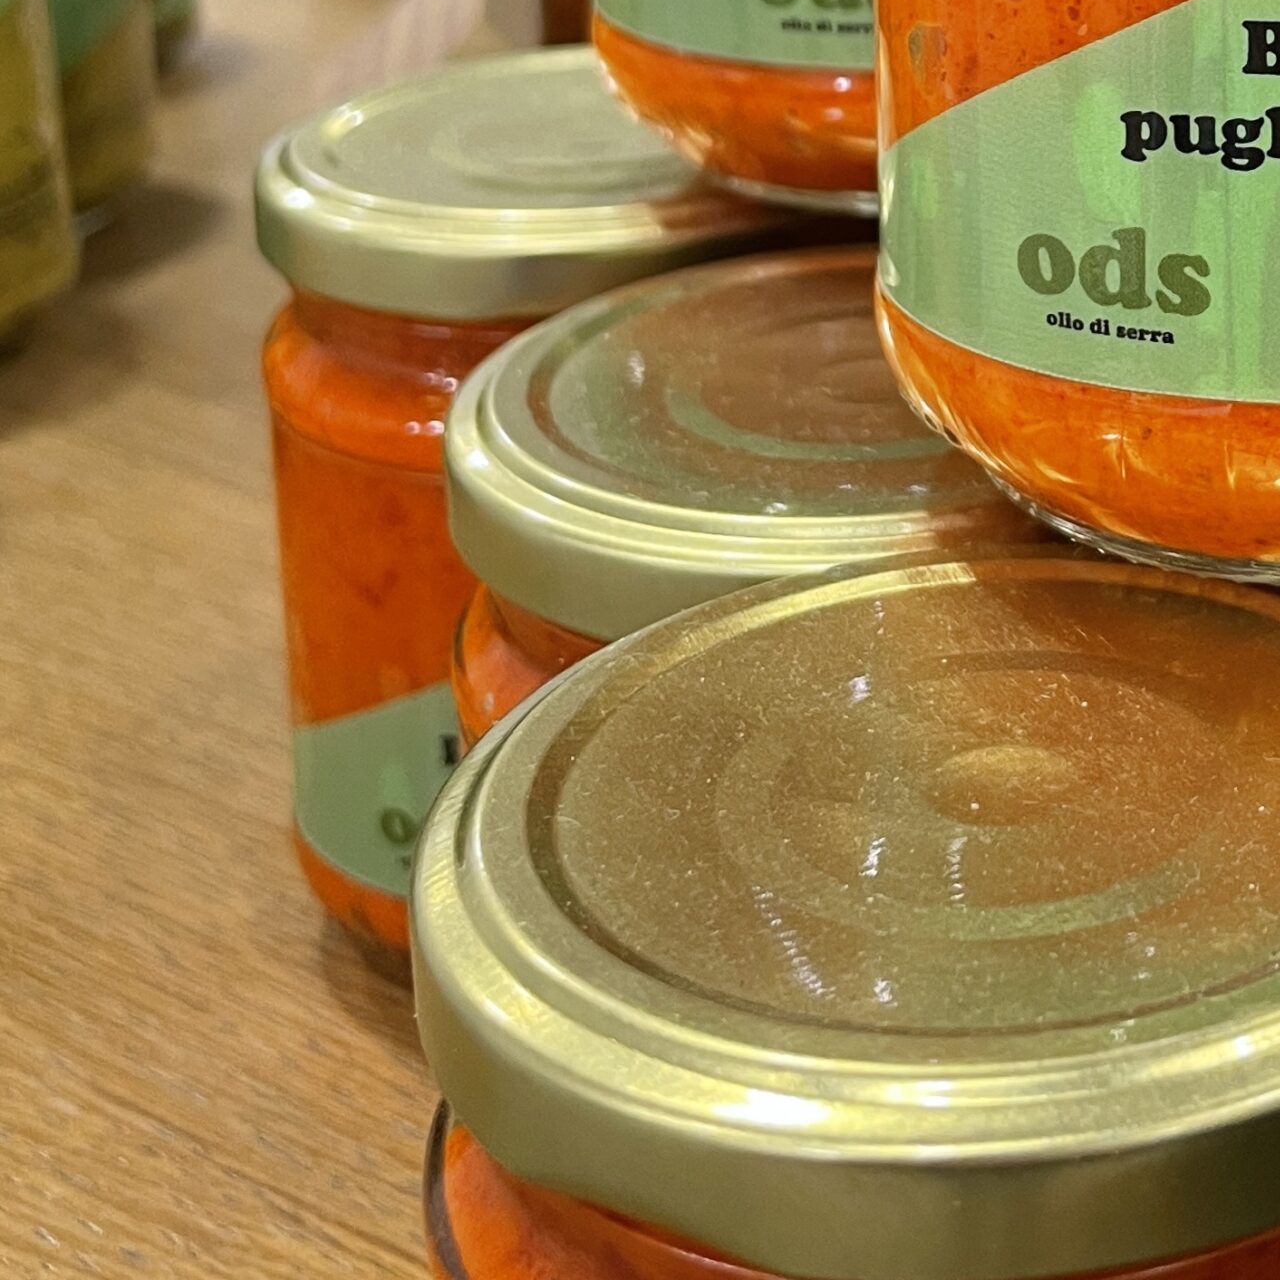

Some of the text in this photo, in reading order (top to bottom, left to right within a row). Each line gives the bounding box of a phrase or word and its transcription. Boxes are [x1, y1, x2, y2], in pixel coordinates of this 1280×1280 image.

[1018, 227, 1211, 317] ods
[1089, 318, 1110, 336] di
[1116, 325, 1174, 344] serra
